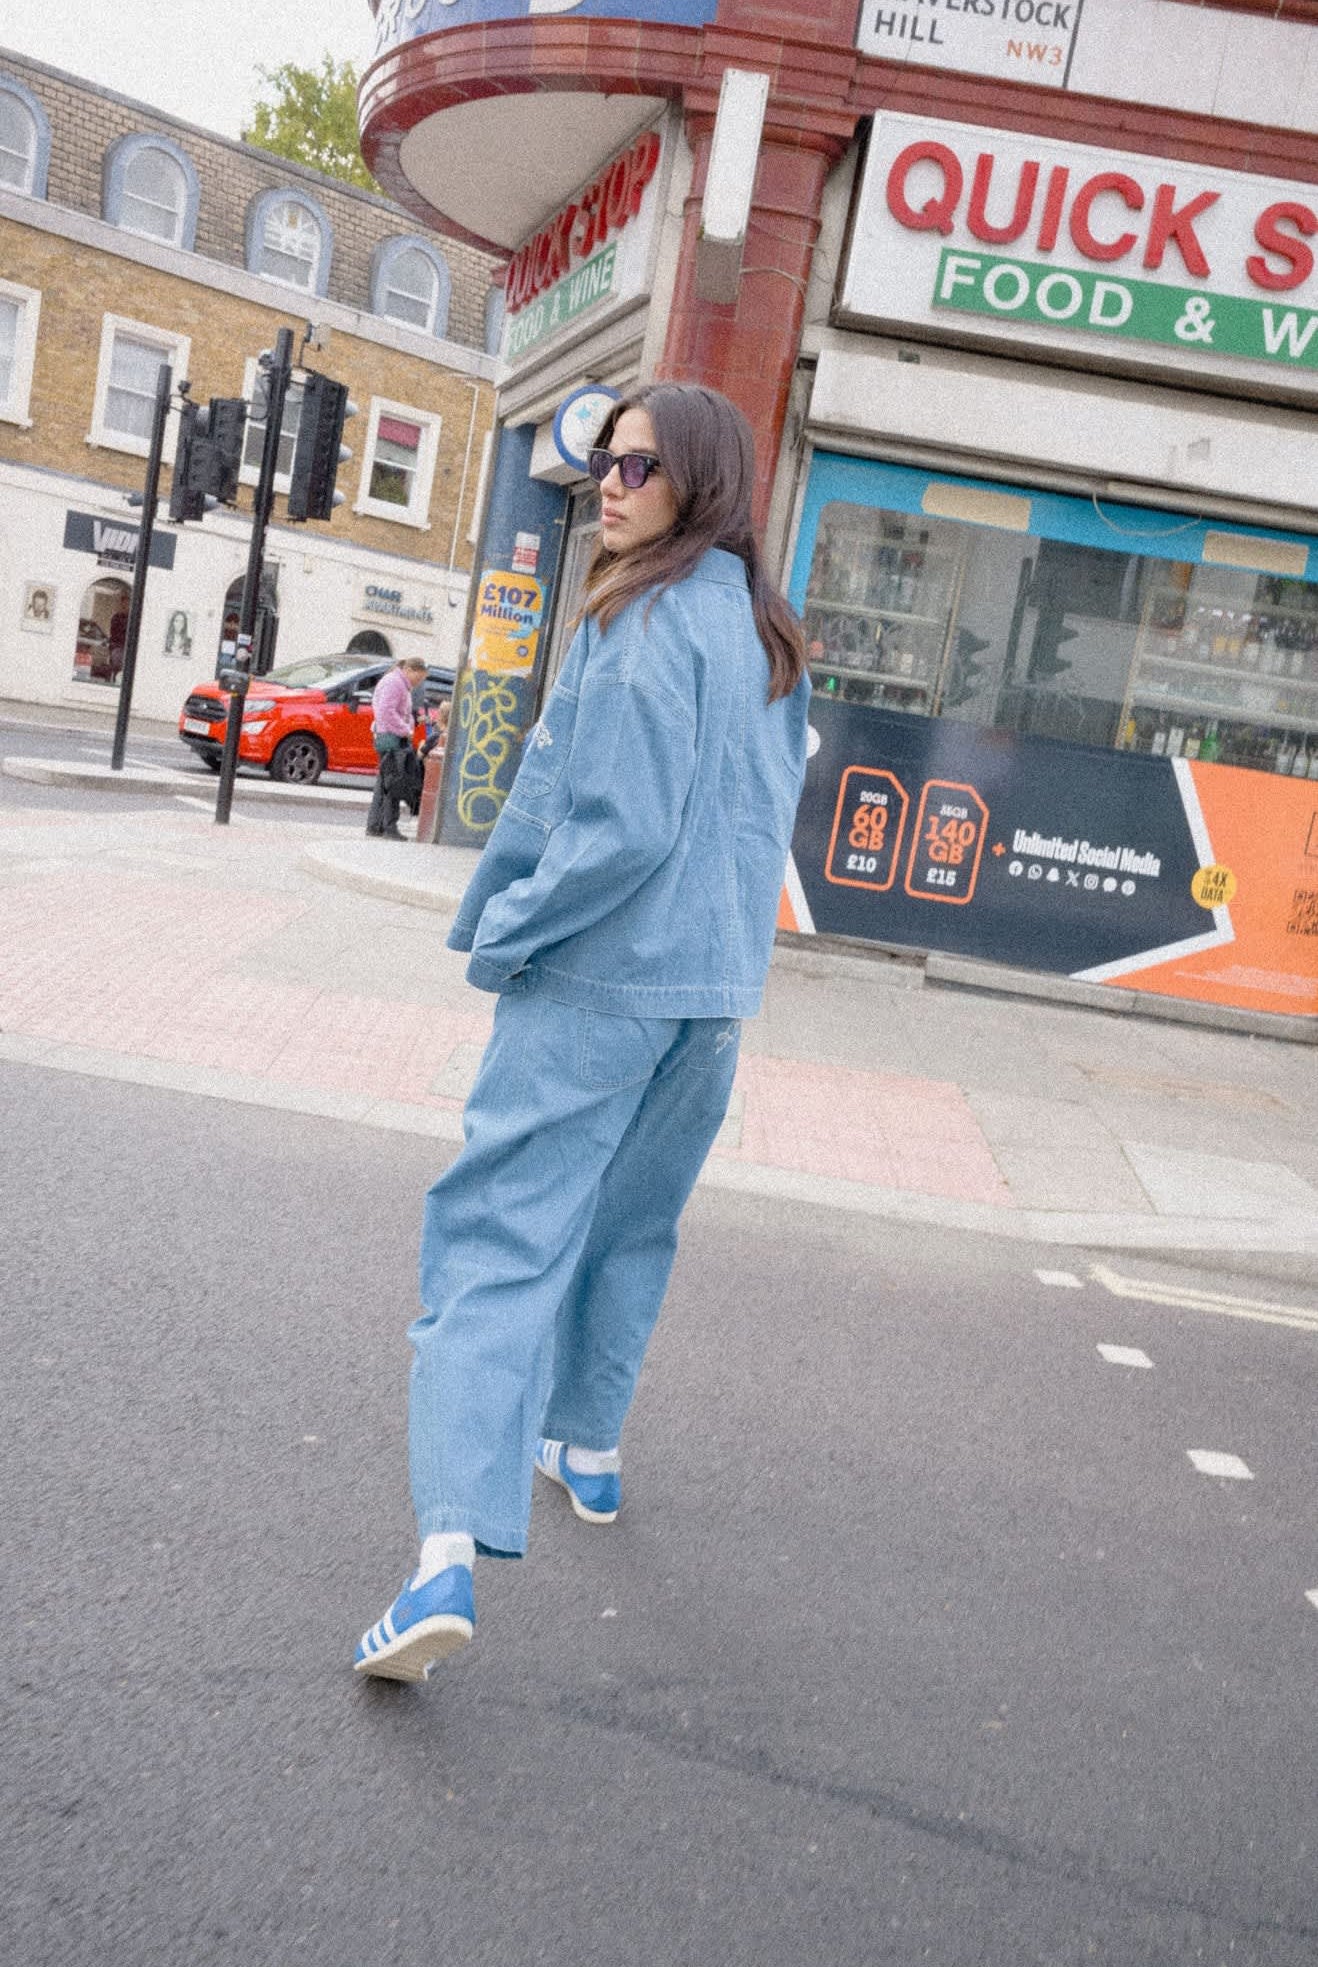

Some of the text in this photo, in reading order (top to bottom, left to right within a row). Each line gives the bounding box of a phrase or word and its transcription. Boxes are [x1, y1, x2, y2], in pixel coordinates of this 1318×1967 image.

[874, 9, 943, 45] HILL
[1006, 39, 1063, 67] NW3
[572, 129, 661, 258] STOP
[886, 140, 1222, 278] QUICK
[568, 250, 615, 313] WINE
[939, 255, 1134, 328] FOOD
[1173, 296, 1216, 344] &
[483, 582, 538, 609] £107
[480, 603, 534, 625] Million
[852, 804, 889, 830] 60
[848, 826, 885, 852] GB
[925, 815, 977, 847] 140
[845, 854, 878, 874] £10
[927, 840, 965, 866] GB
[1012, 828, 1080, 863] Unlimited
[1076, 840, 1123, 870] Social
[1119, 846, 1162, 878] Media
[925, 867, 958, 887] £15
[1200, 885, 1225, 903] DATA
